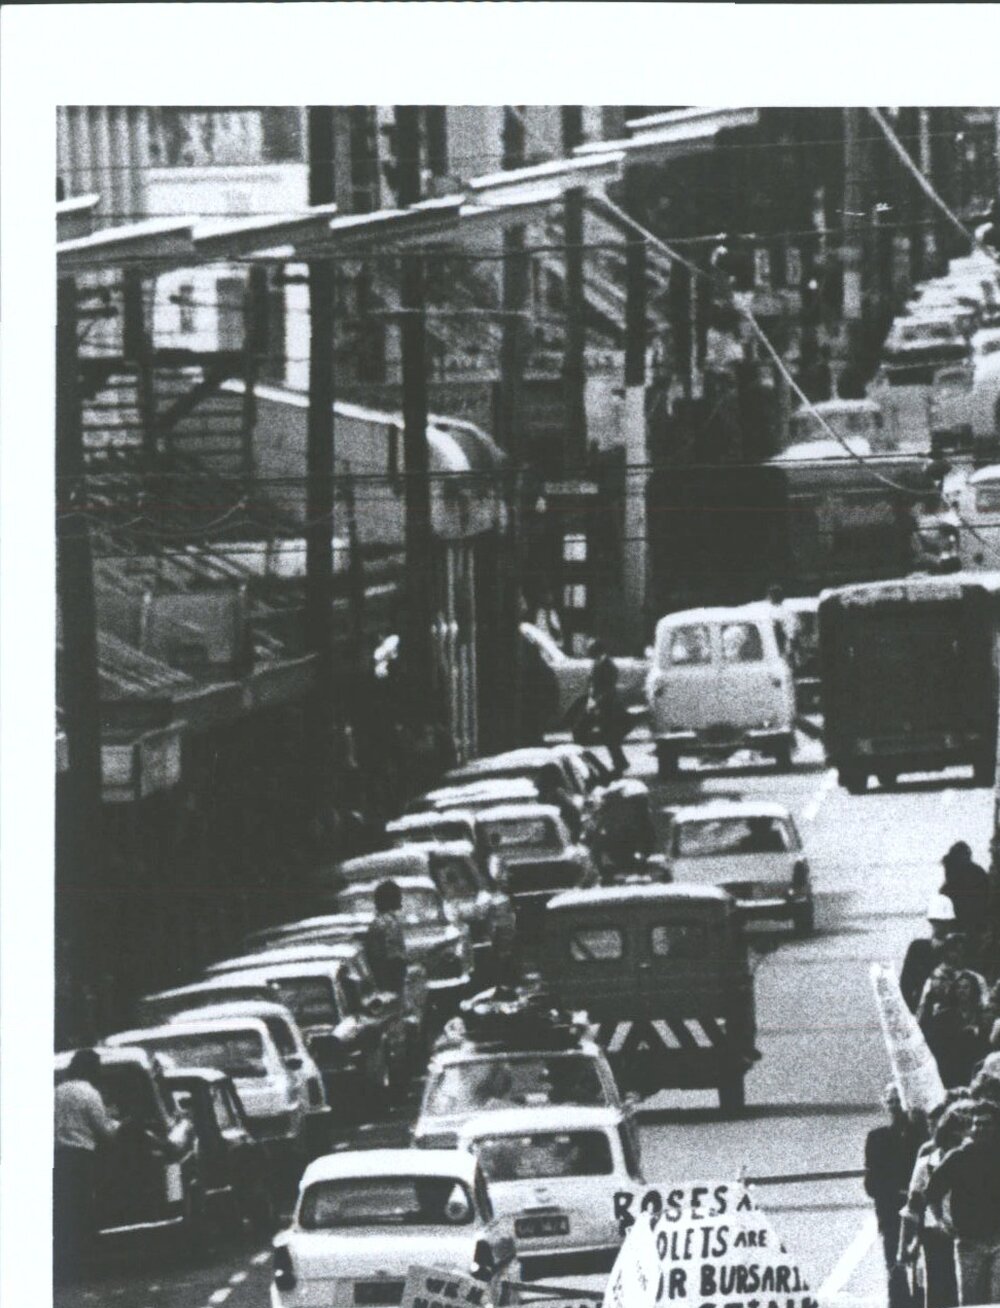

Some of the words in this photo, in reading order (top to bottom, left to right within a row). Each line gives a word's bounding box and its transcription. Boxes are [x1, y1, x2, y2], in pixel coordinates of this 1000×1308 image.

[656, 1225, 730, 1262] OLETS
[733, 1229, 768, 1248] ARE
[700, 1263, 810, 1298] BURSARI
